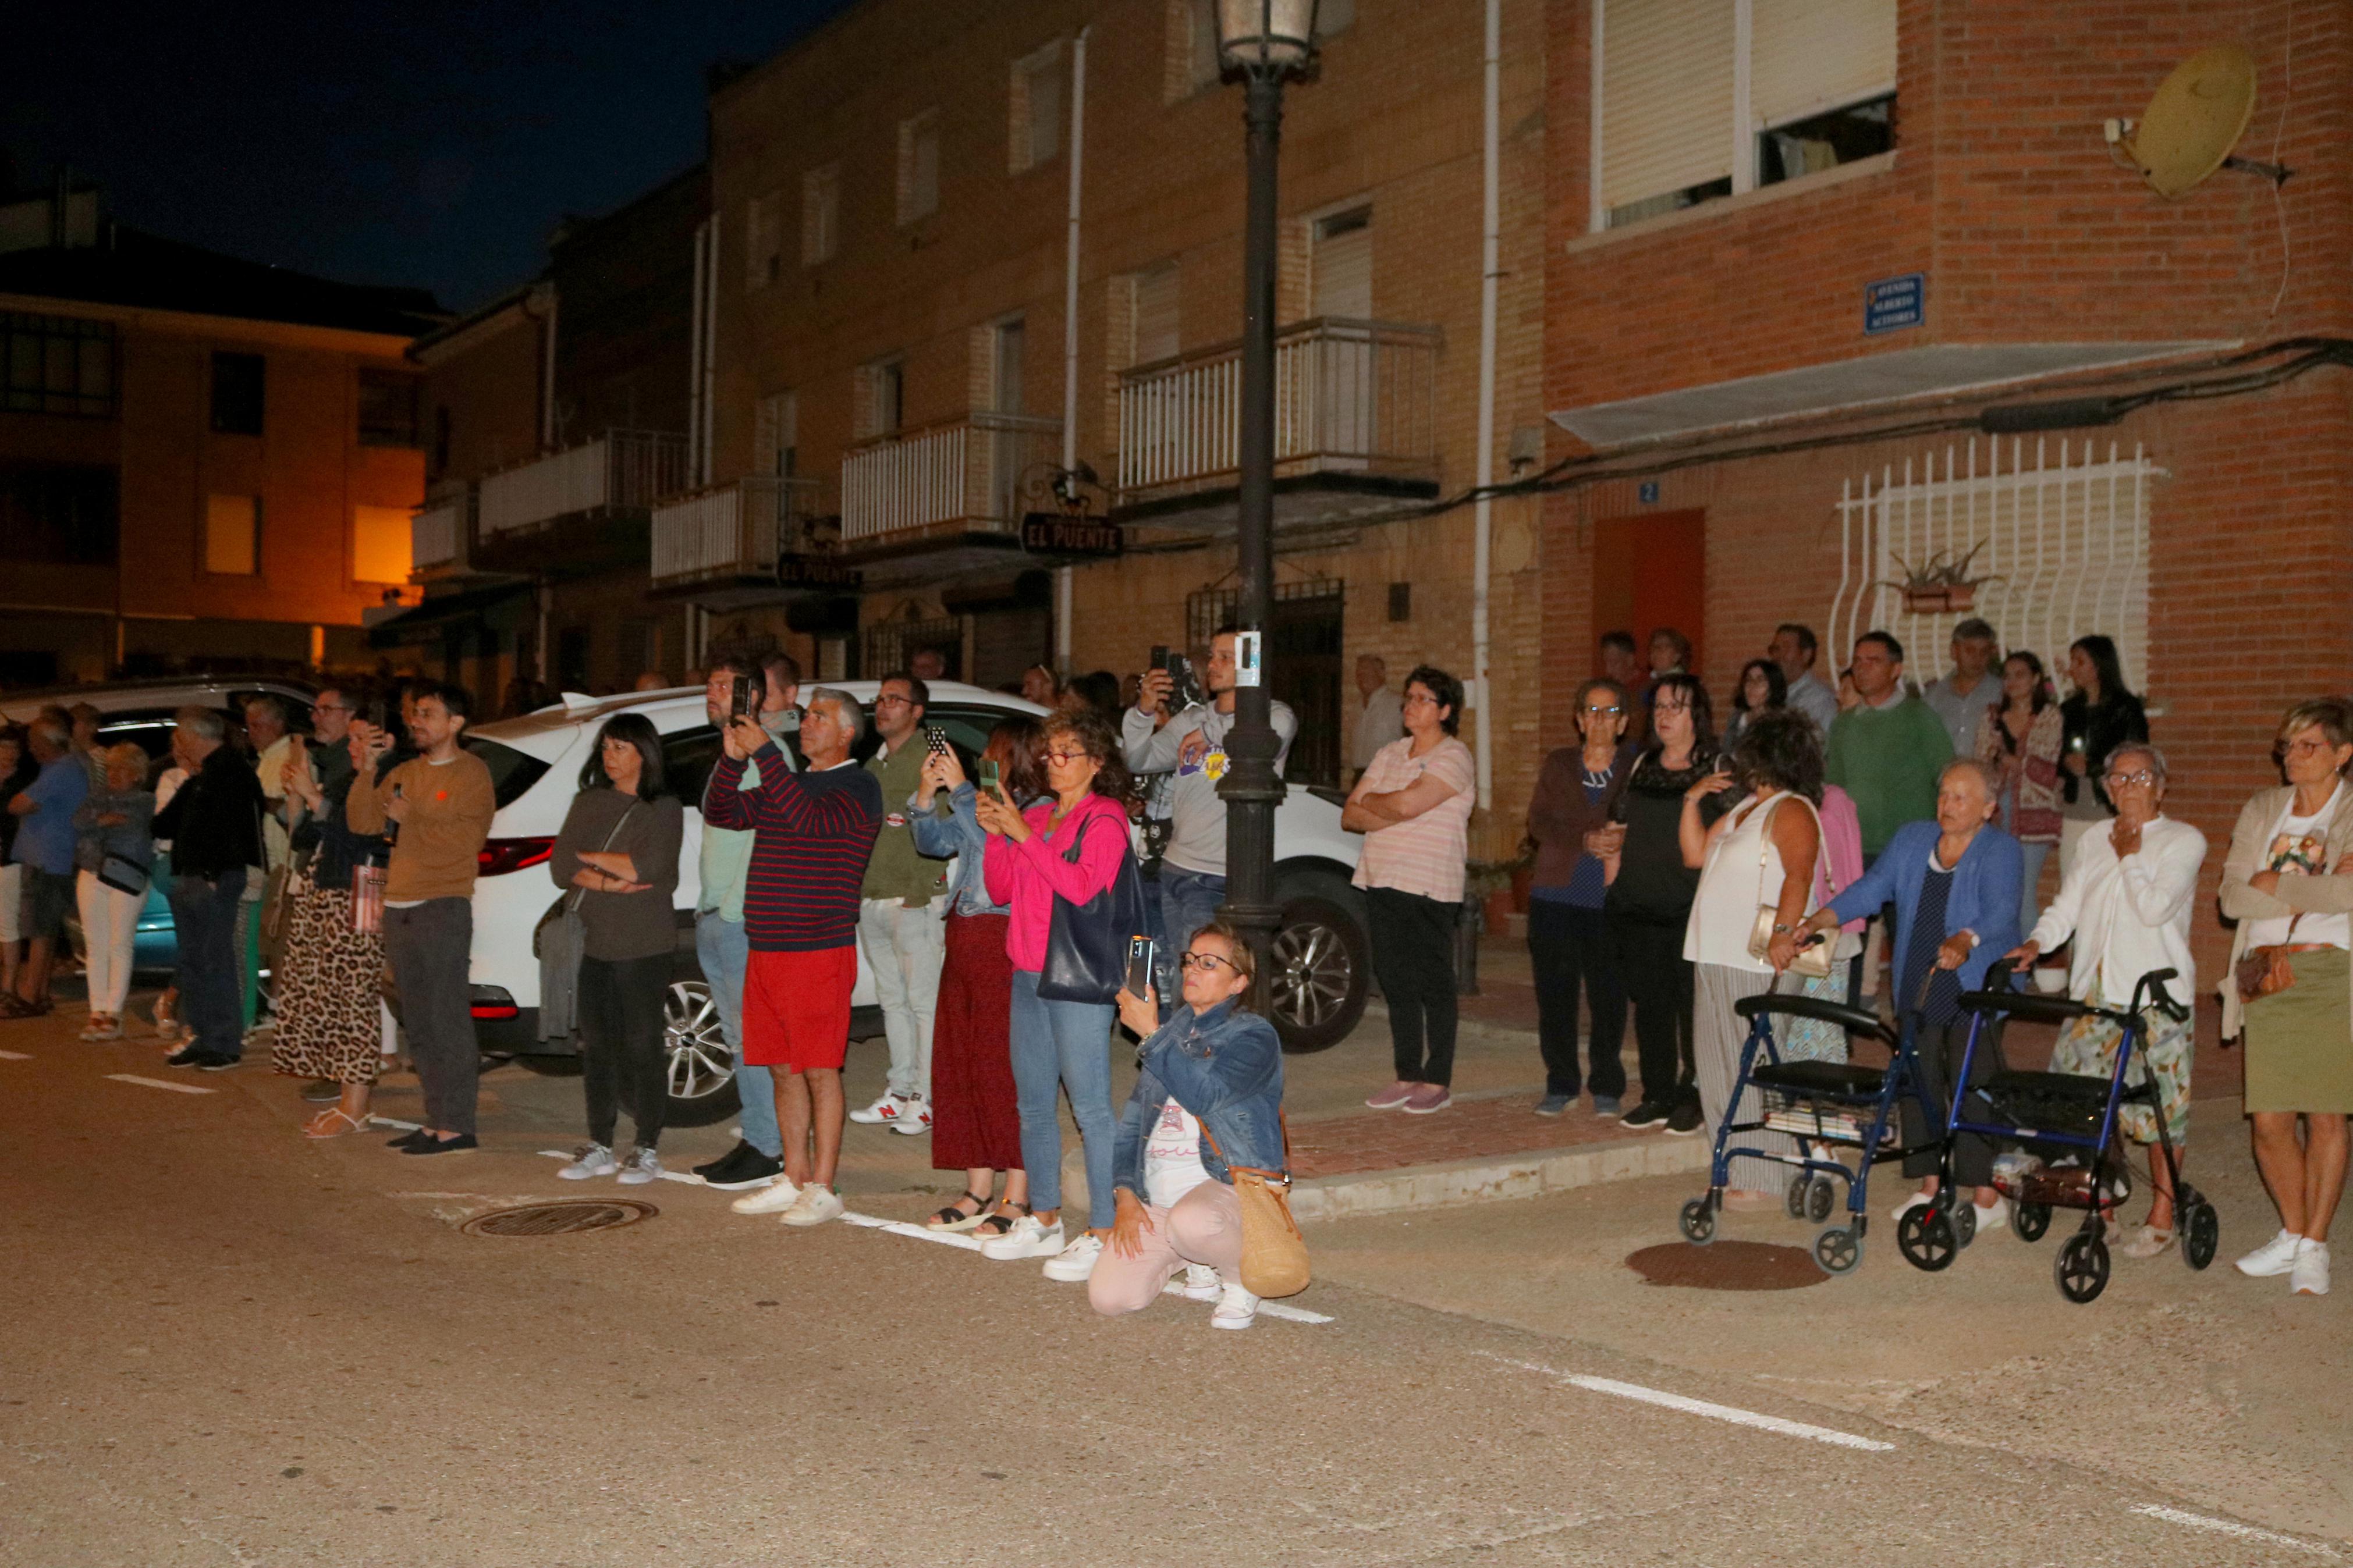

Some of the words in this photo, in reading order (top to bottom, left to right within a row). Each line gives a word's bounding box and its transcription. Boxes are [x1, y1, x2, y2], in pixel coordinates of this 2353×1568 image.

[1874, 295, 1914, 311] ALBERTO
[1027, 524, 1048, 547] EL
[1052, 525, 1117, 550] PUENTE
[782, 562, 799, 581] EL
[804, 563, 856, 585] PUENTE
